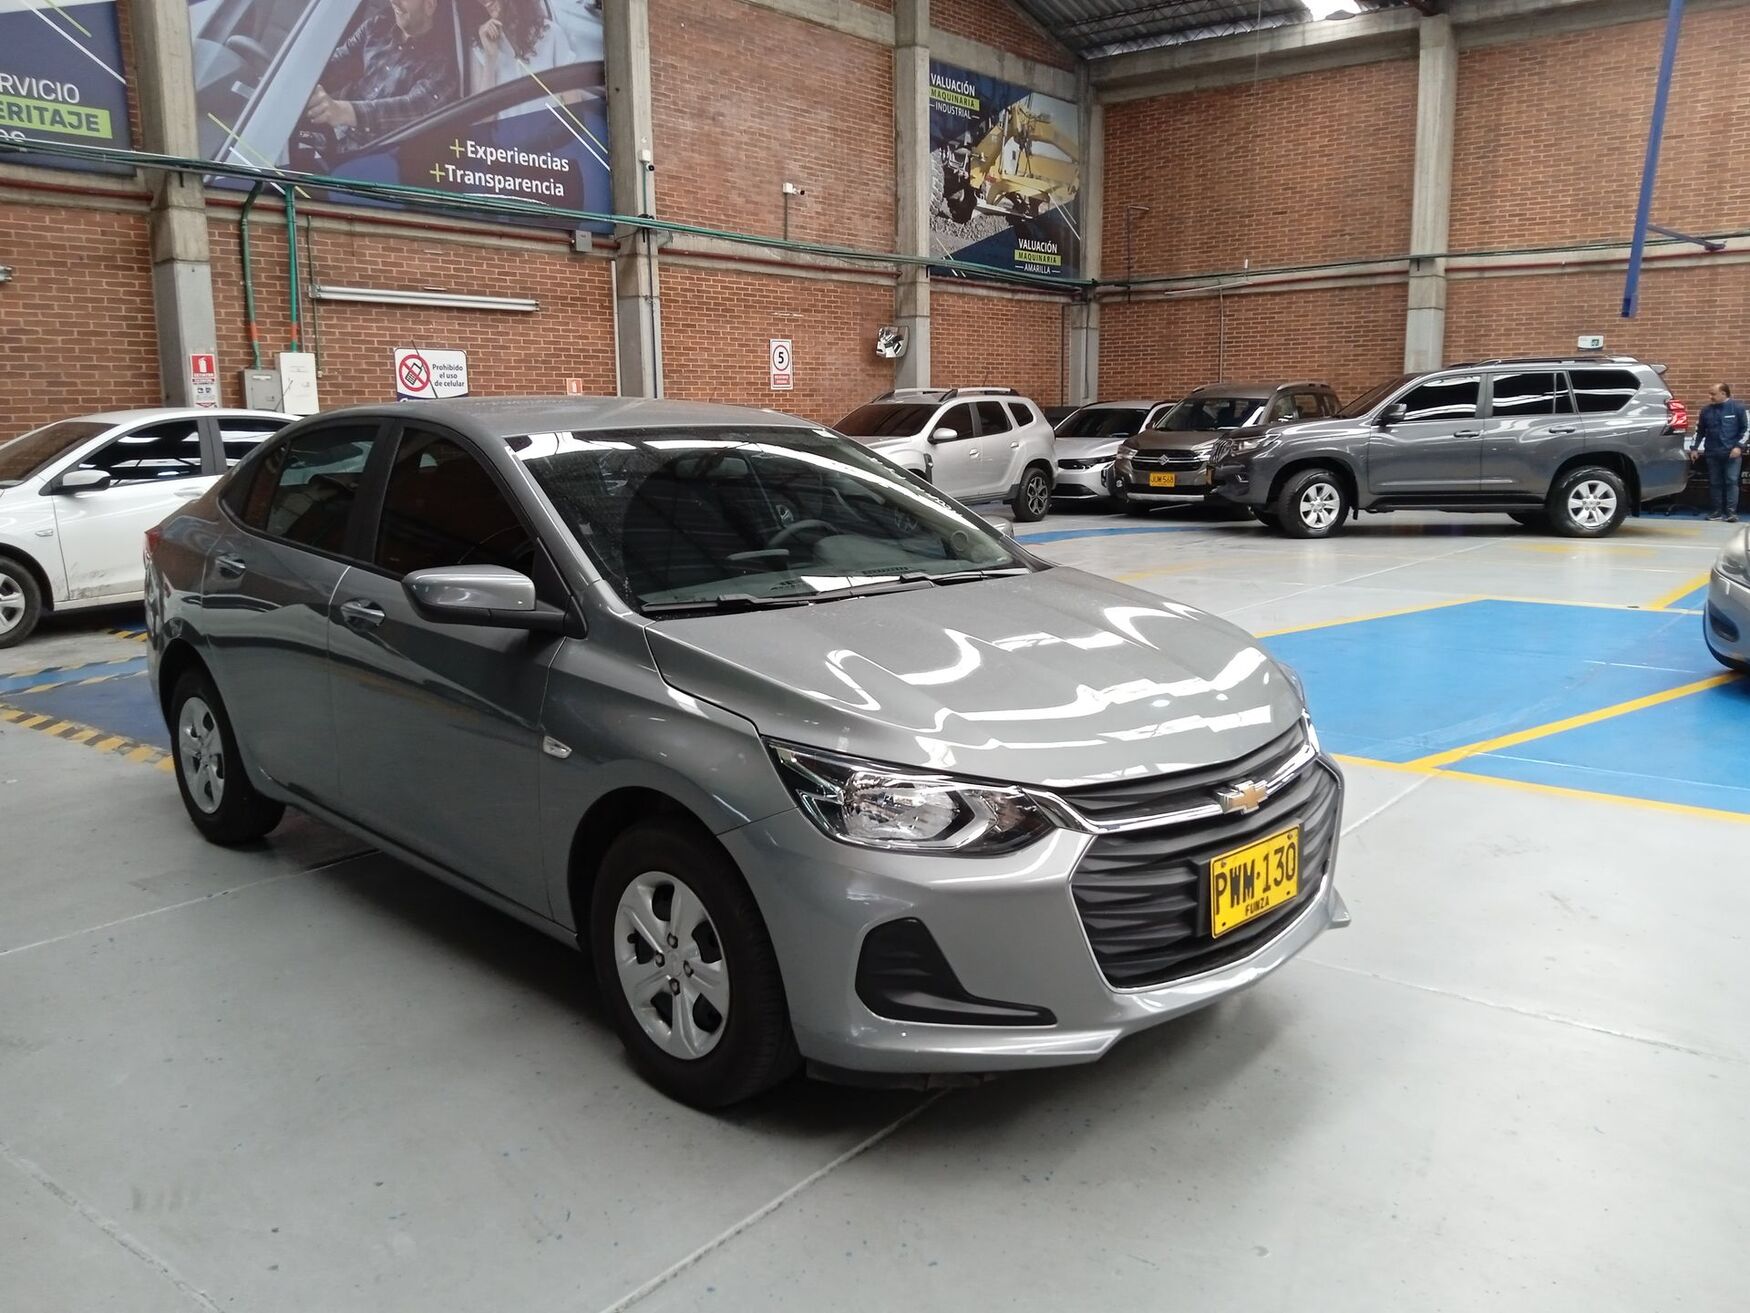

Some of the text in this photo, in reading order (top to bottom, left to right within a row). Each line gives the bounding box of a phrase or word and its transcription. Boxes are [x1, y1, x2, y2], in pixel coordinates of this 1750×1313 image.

[930, 72, 976, 97] VALUACIÓN
[931, 88, 976, 108] MAQUINARIA
[935, 101, 972, 120] INDUSTRIAL
[1018, 238, 1058, 254] VALUACIÓN
[1018, 251, 1057, 264] MAQUINARIA
[1023, 263, 1051, 275] AMARILLA
[778, 351, 785, 365] 5
[432, 363, 464, 372] Prohibido
[443, 380, 465, 388] celular
[1245, 895, 1270, 917] FUNZA
